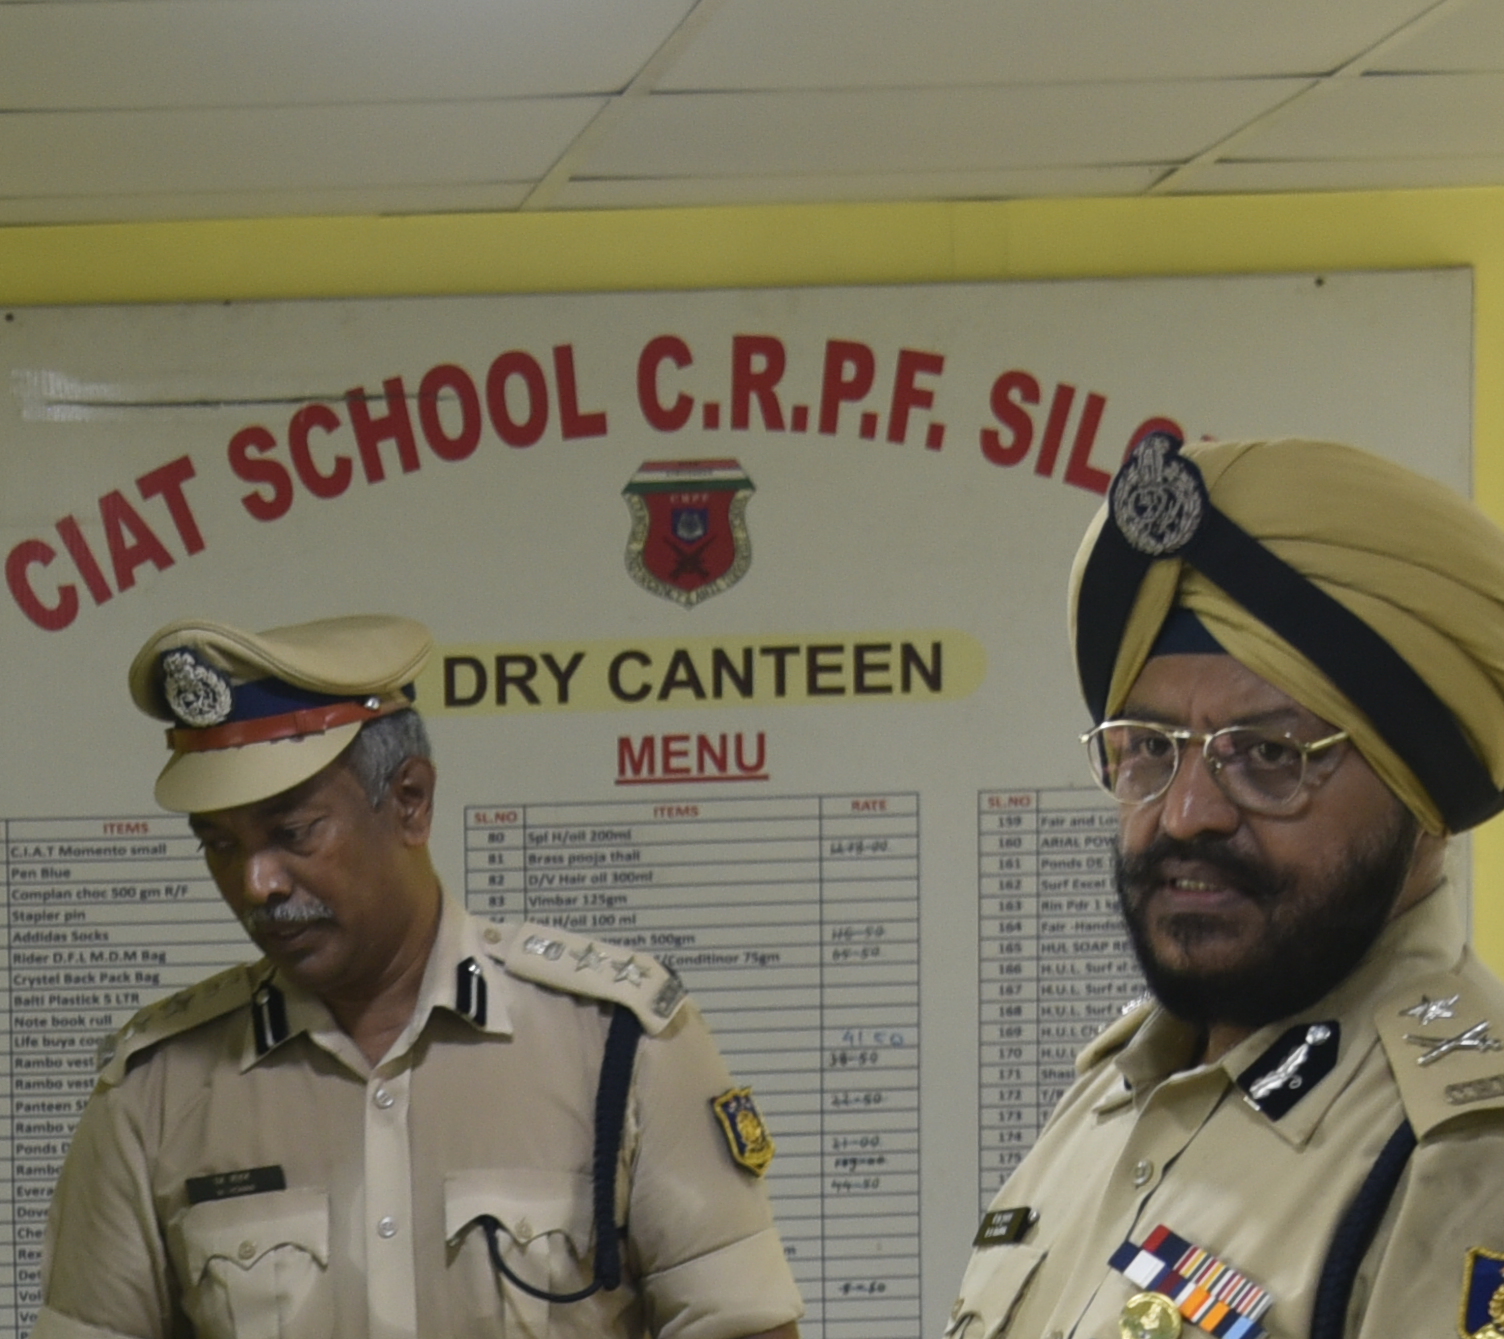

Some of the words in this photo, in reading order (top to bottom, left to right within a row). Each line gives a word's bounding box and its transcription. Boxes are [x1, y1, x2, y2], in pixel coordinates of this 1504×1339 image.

[4, 454, 206, 632] CIAT
[226, 343, 608, 522] SCHOOL
[636, 333, 947, 452] C.R.P.F.
[444, 651, 586, 708] DRY
[607, 641, 944, 703] CANTEEN
[616, 731, 767, 777] MENU
[850, 799, 887, 812] RATE
[988, 796, 1031, 809] SL.NO
[653, 804, 699, 818] ITEMS
[998, 816, 1022, 828] 159
[1069, 815, 1095, 826] and
[103, 822, 149, 836] ITEMS
[590, 829, 632, 842] 200ml
[998, 837, 1022, 848] 160
[58, 844, 127, 857] Momento
[130, 843, 167, 855] small
[528, 853, 564, 865] Brass
[568, 852, 606, 867] pooja
[998, 858, 1022, 869] 161
[1040, 858, 1082, 869] Ponds
[11, 867, 37, 879] Pen
[40, 867, 71, 878] Blue
[559, 872, 587, 884] Hair
[612, 870, 652, 883] 300ml
[998, 879, 1022, 890] 162
[1041, 879, 1069, 890] Surf
[1072, 879, 1105, 890] Excel
[11, 888, 72, 903] Complan
[75, 886, 107, 899] choc
[111, 886, 136, 898] 500
[138, 888, 161, 900] gm
[529, 894, 578, 907] Vimbar
[582, 893, 627, 907] 125gm
[998, 900, 1022, 911] 163
[1040, 900, 1062, 911] Rin
[1066, 899, 1090, 911] Pdr
[12, 909, 60, 924] Stapler
[62, 909, 86, 923] pin
[592, 914, 614, 926] 100
[619, 913, 637, 925] ml
[12, 930, 67, 943] Addidas
[71, 930, 109, 941] Socks
[650, 933, 695, 947] 500gm
[1073, 941, 1109, 952] SOAP
[744, 951, 781, 965] 75gm
[1085, 962, 1112, 974] Surf
[13, 973, 60, 988] Crystel
[63, 972, 95, 984] Back
[99, 971, 130, 983] Pack
[134, 971, 160, 985] Bag
[14, 995, 44, 1006] Balti
[48, 993, 99, 1005] Plastick
[103, 993, 112, 1004] 5
[115, 992, 139, 1004] LTR
[14, 1016, 47, 1027] Note
[51, 1015, 85, 1026] book
[89, 1014, 112, 1026] rull
